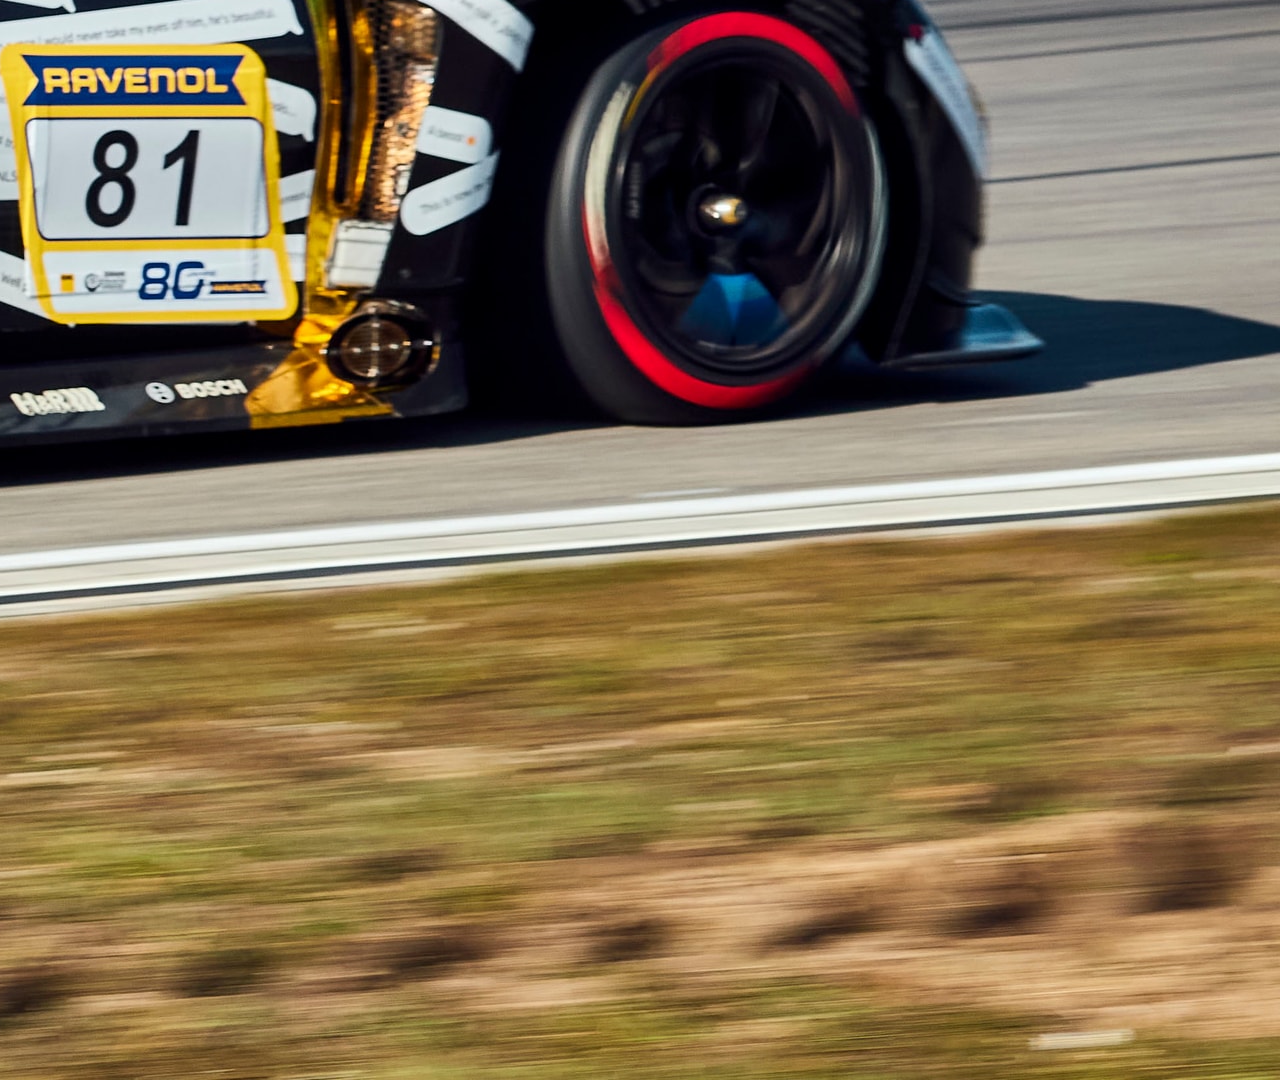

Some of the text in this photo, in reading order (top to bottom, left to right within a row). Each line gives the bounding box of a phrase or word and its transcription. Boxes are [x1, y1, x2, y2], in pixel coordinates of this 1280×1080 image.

[42, 67, 229, 94] RAVENOL
[84, 128, 201, 228] 81
[174, 378, 249, 400] BOSCH
